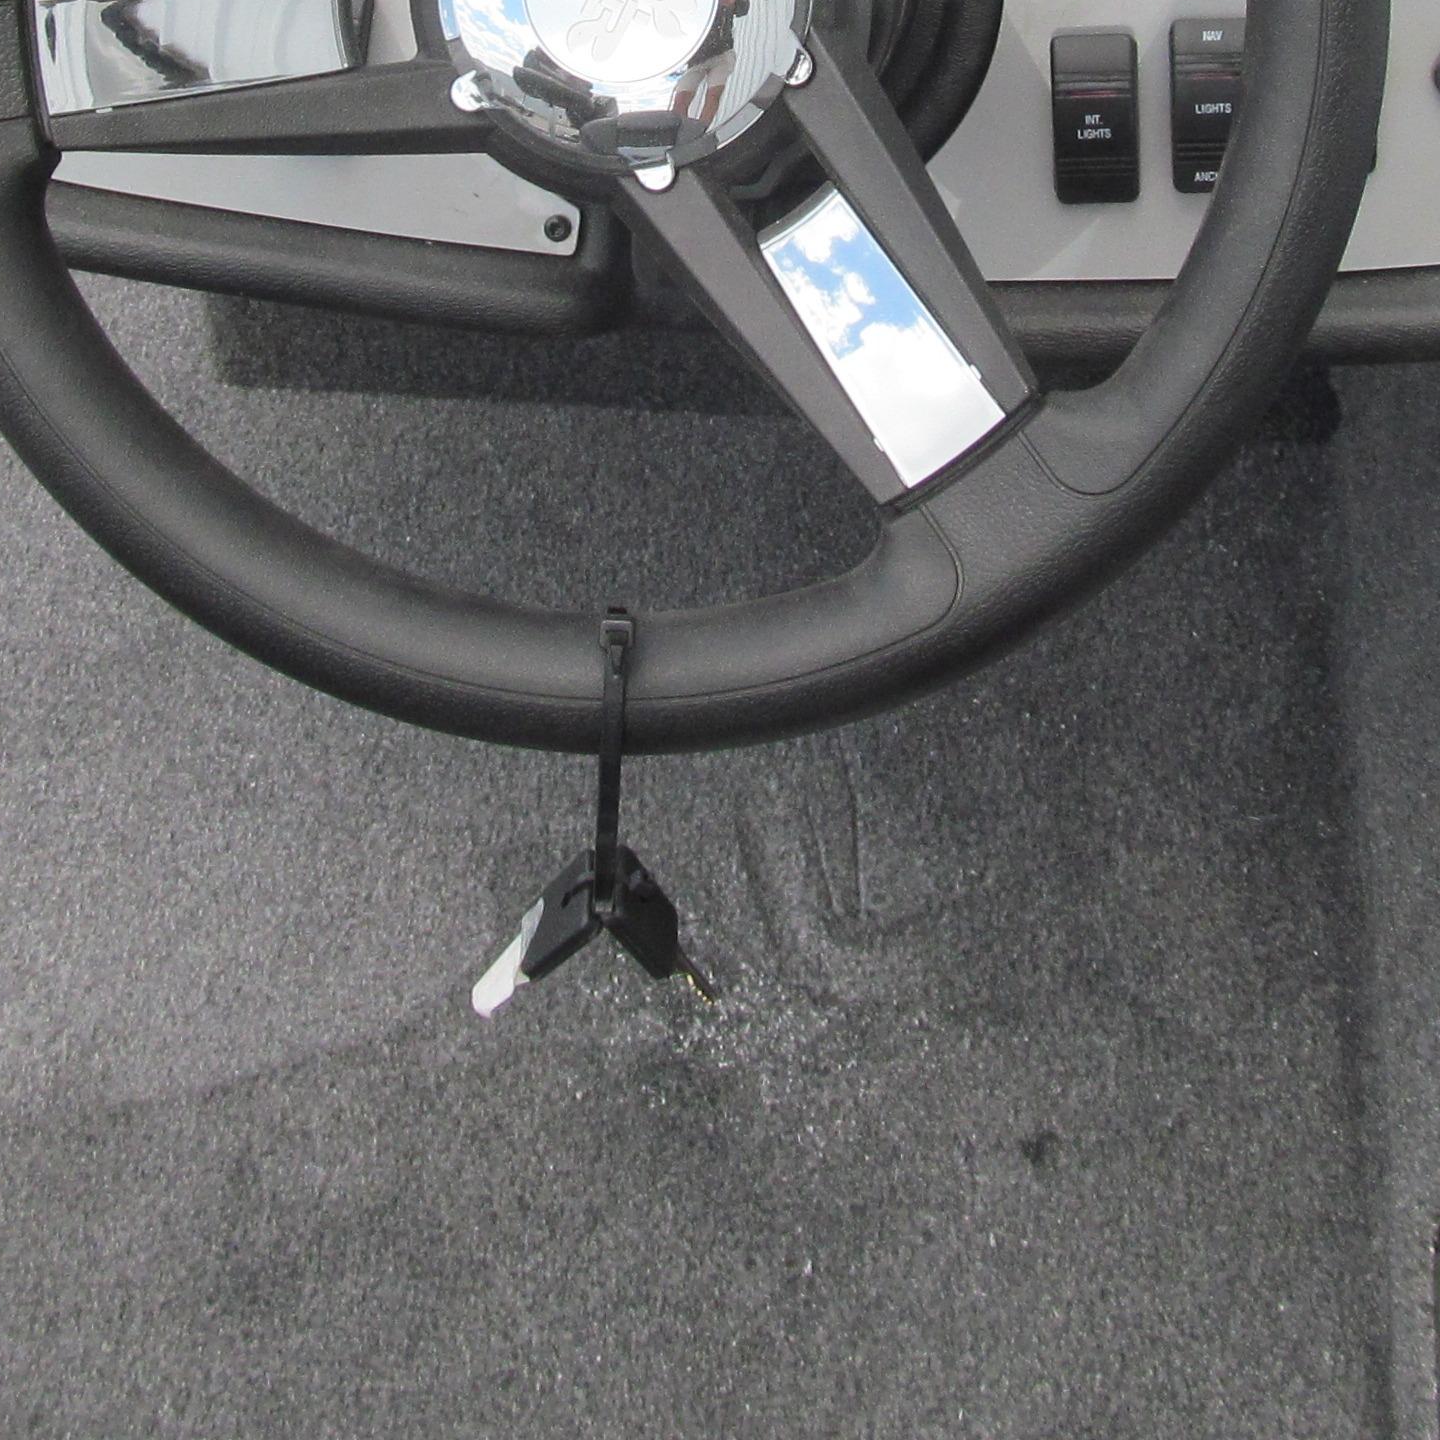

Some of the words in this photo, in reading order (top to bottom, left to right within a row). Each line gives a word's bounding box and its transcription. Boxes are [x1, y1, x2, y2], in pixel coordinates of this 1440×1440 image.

[1202, 30, 1223, 42] NAV
[1195, 103, 1233, 115] LIGHTS
[1085, 114, 1104, 126] INT.
[1077, 128, 1112, 140] LIGHTS
[1194, 171, 1218, 182] ANC
